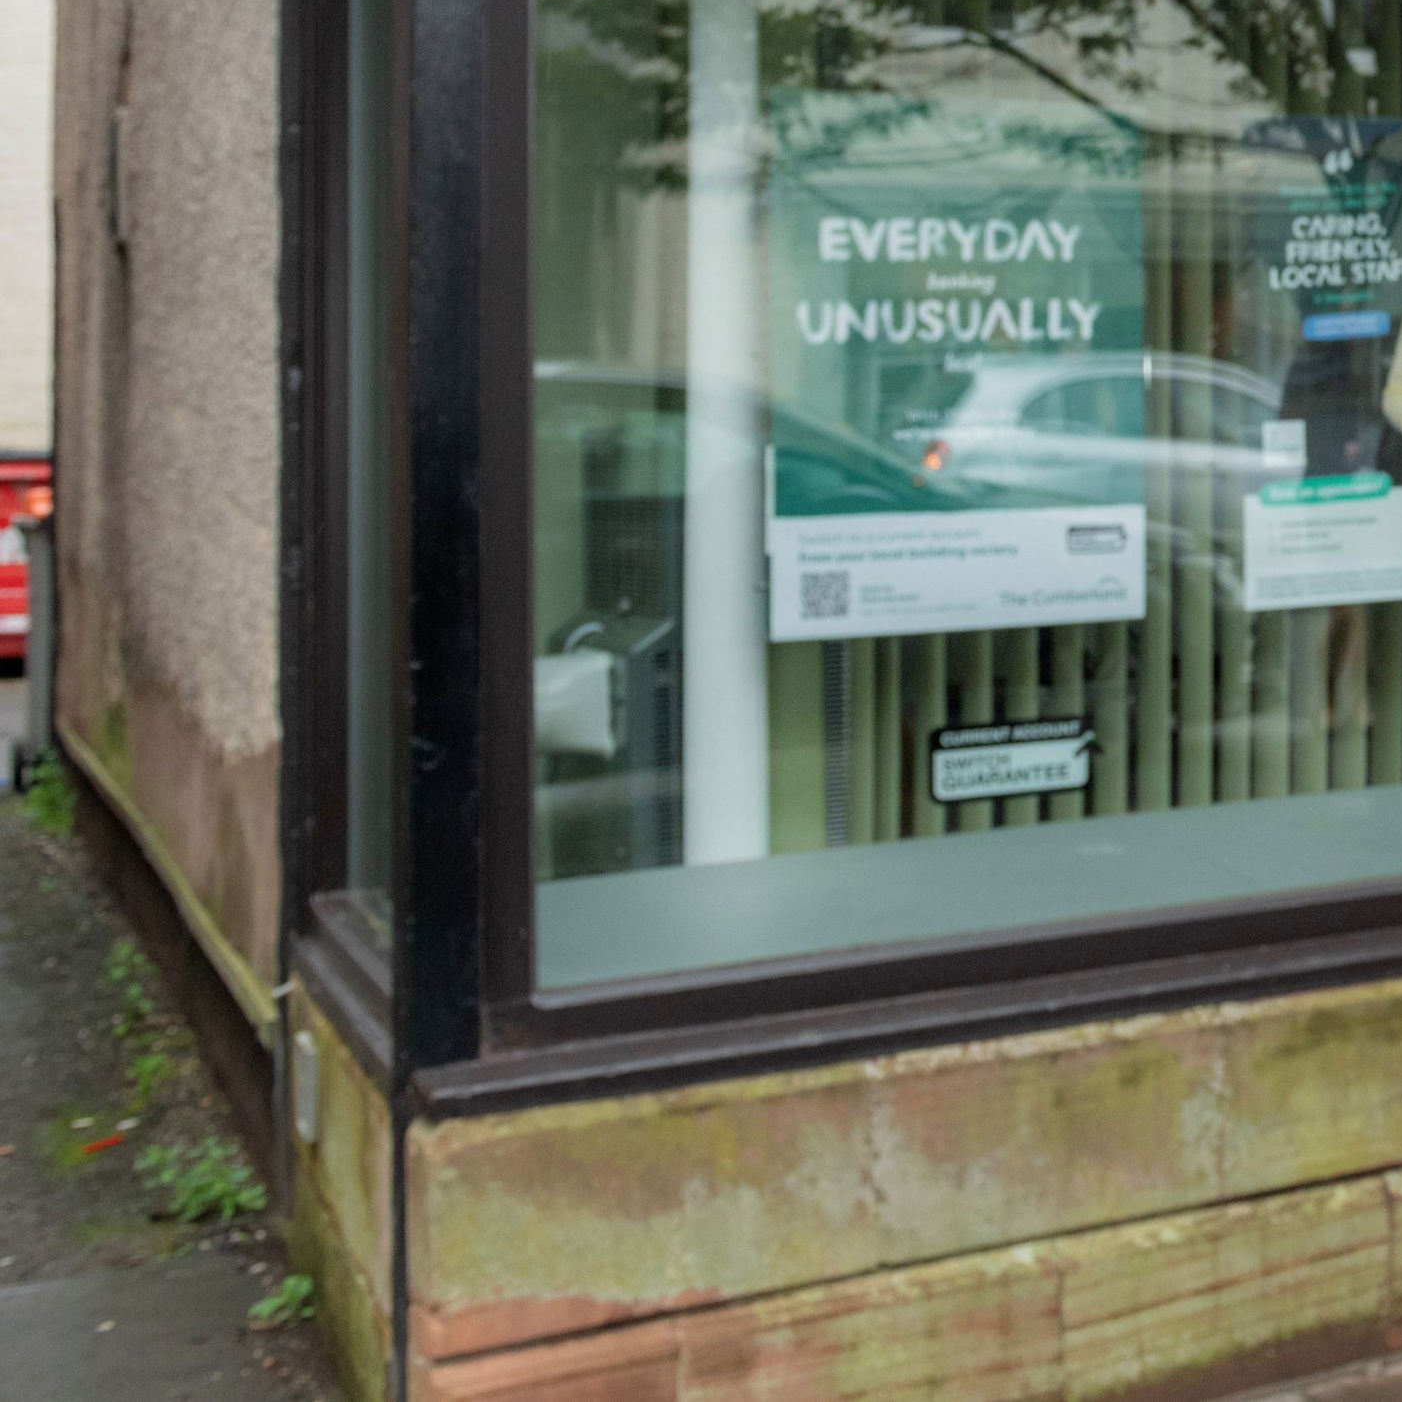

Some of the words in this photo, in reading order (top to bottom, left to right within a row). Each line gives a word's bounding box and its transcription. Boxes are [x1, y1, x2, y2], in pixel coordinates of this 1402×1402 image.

[818, 216, 1082, 262] EVERYDAY
[1291, 212, 1387, 239] CARING,
[1285, 238, 1397, 264] FRIENDLY,
[926, 272, 997, 296] banking
[1268, 263, 1347, 291] LOCAL
[796, 298, 1101, 345] UNUSUALLY
[940, 725, 1012, 748] CURRENT
[1013, 719, 1081, 741] ACCOUNT
[943, 763, 1070, 791] GUARANTEE
